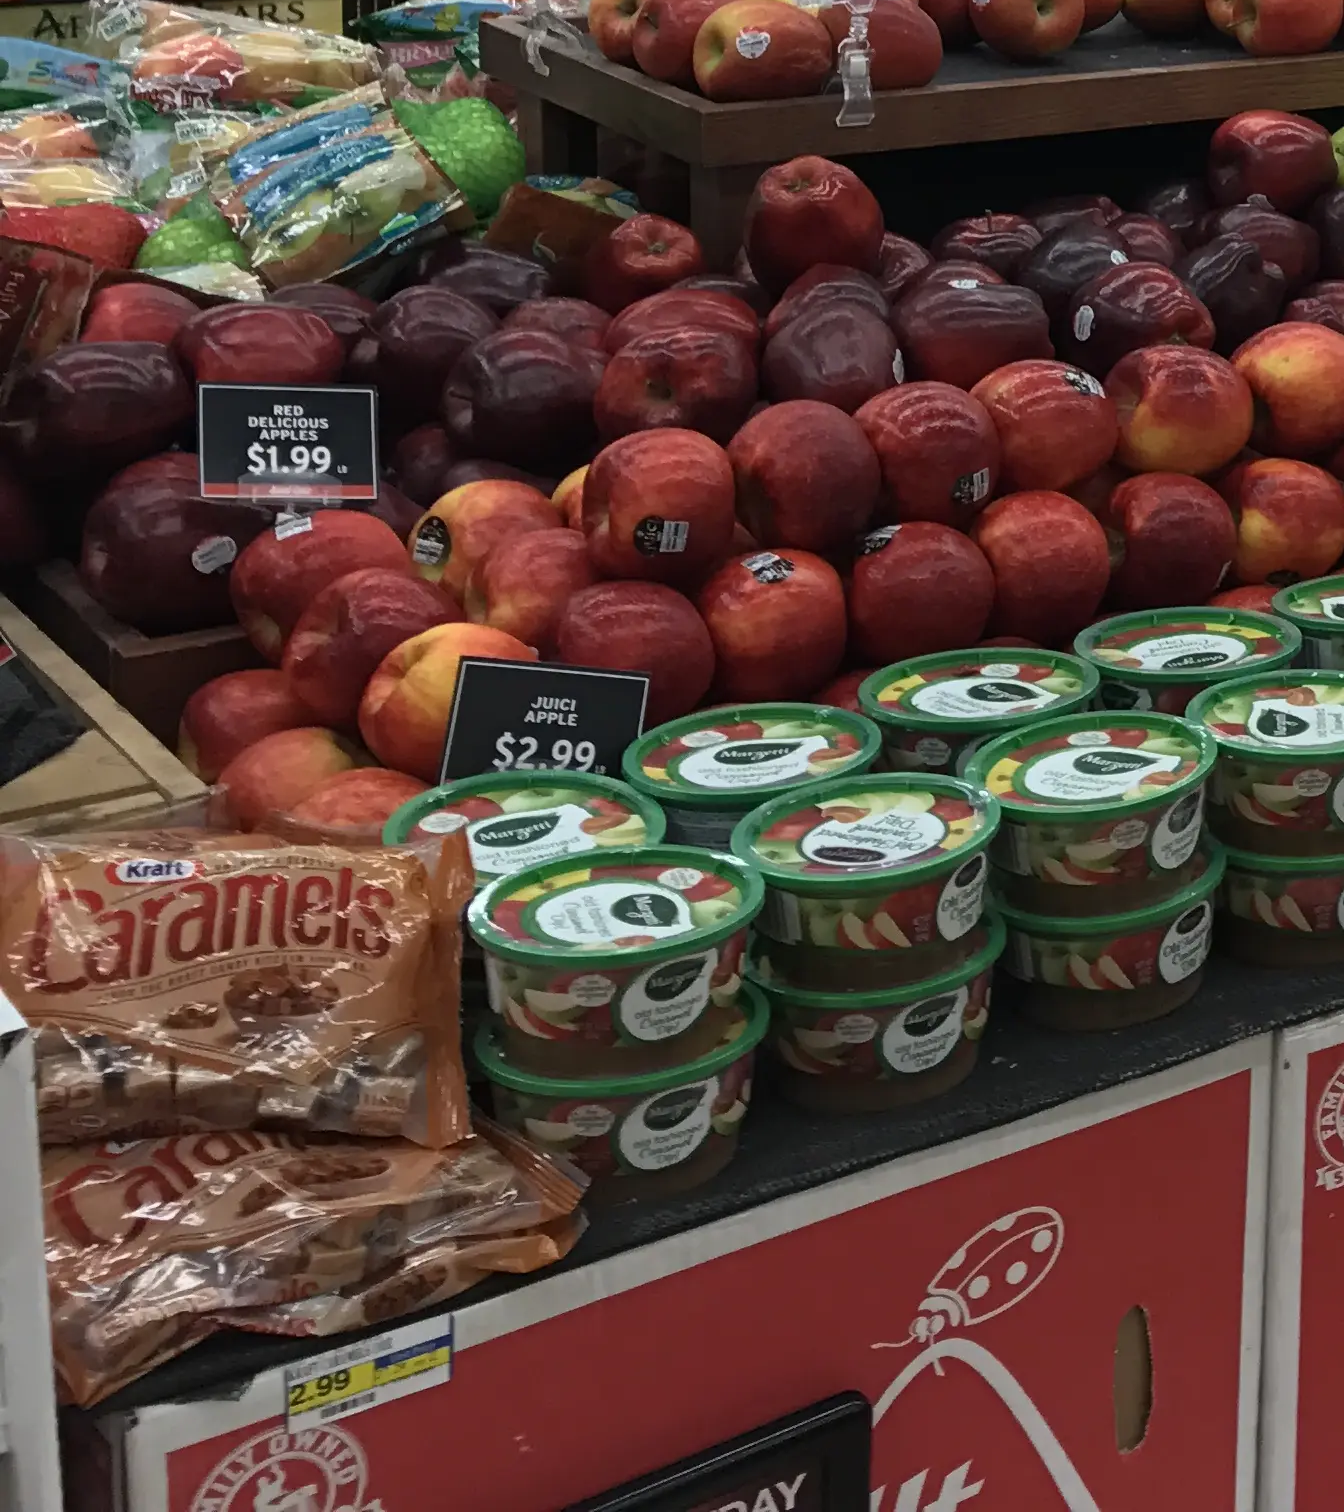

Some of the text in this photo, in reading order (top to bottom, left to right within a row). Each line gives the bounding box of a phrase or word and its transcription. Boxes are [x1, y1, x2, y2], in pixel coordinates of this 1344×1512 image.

[273, 404, 304, 417] RED
[248, 416, 329, 429] DELICIOUS
[259, 429, 319, 441] APPLES
[247, 442, 332, 476] $1.99
[531, 696, 577, 712] JUICI
[523, 709, 578, 728] APPLE
[492, 732, 596, 775] $2.99
[479, 820, 553, 843] Marzetti
[125, 858, 185, 881] Kraft
[25, 867, 395, 994] Caramels
[289, 1369, 351, 1407] 2.99
